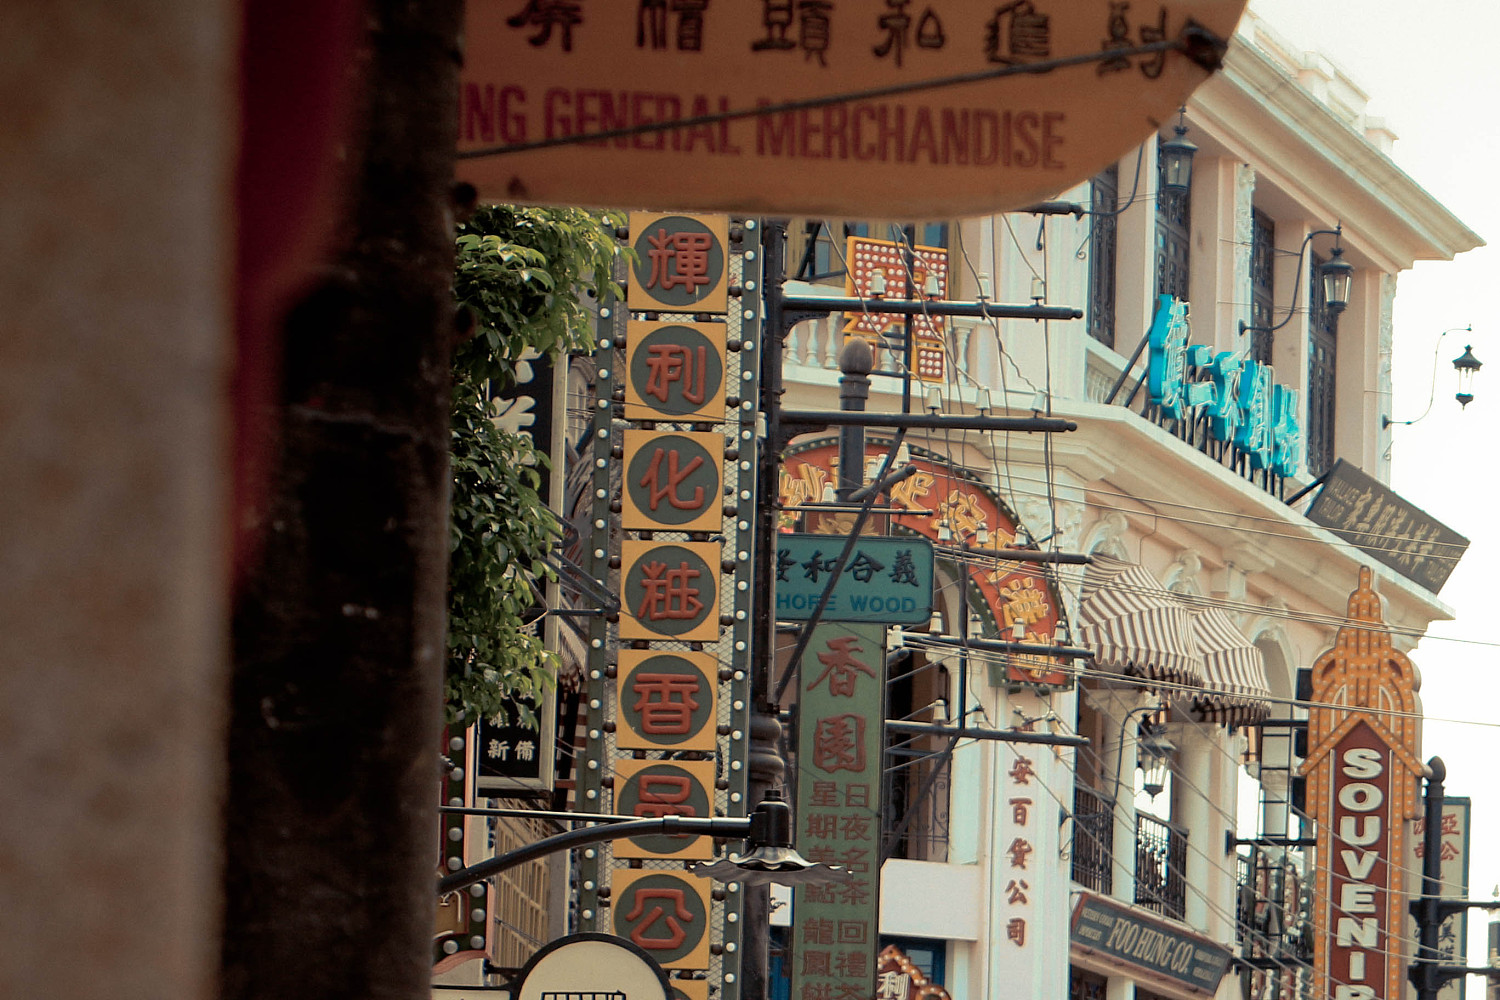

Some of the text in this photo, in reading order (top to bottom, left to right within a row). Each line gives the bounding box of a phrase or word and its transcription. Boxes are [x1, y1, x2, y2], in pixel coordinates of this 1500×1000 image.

[459, 83, 1066, 170] NG GENERAL MERCHANDISE
[849, 594, 916, 612] WOOD
[806, 635, 876, 774] 香園
[1105, 916, 1140, 954] FOO
[1132, 927, 1177, 967] HUNG
